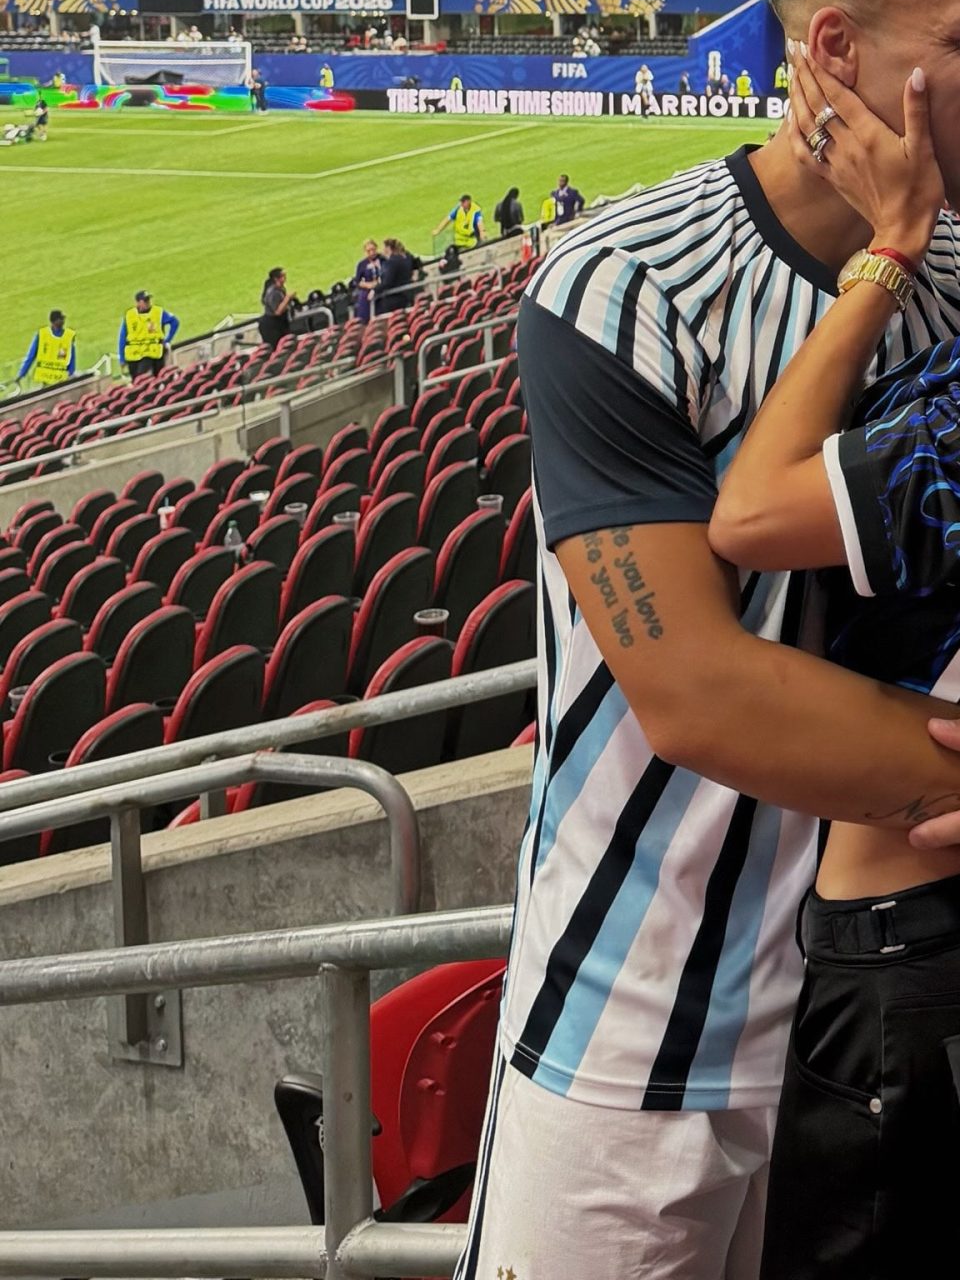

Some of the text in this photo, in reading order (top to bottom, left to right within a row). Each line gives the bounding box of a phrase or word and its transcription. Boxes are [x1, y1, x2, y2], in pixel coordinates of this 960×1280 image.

[552, 62, 588, 78] FIFA
[386, 89, 419, 113] THE
[551, 91, 603, 116] SHOW
[621, 93, 760, 118] MARRIOTT
[590, 566, 618, 608] you
[611, 608, 634, 648] live
[614, 551, 645, 593] you
[635, 592, 663, 640] love
